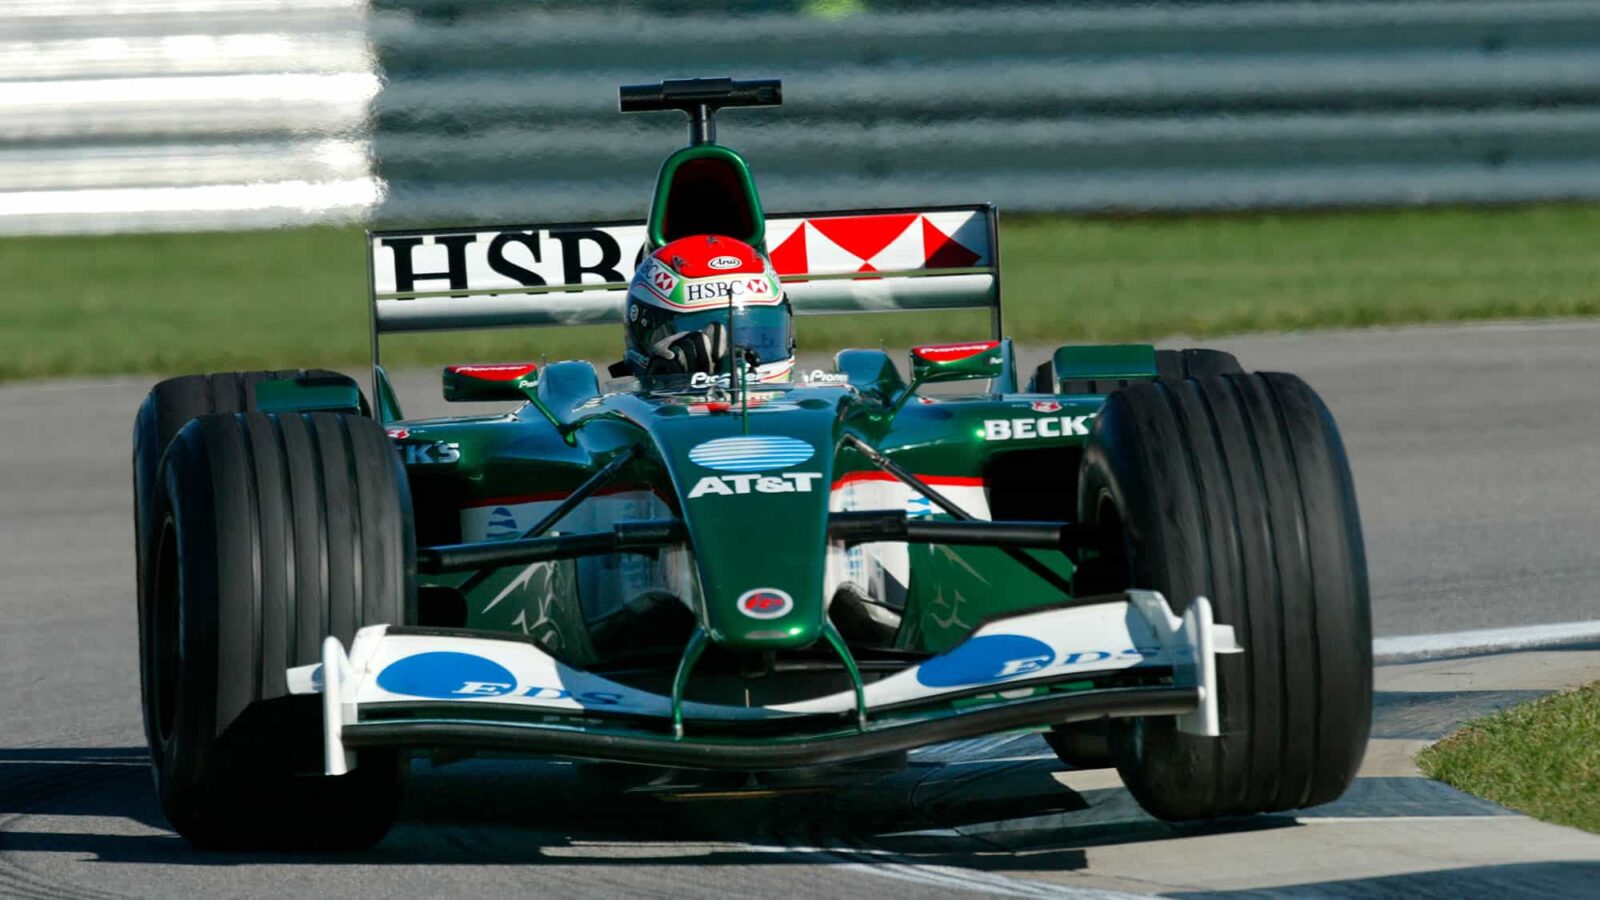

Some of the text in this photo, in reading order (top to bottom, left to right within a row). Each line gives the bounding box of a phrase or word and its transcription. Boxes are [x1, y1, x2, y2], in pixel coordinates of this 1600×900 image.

[381, 228, 646, 300] HSB
[687, 280, 744, 301] HSBC
[984, 413, 1098, 440] BECK'
[687, 472, 823, 499] AT&T
[994, 647, 1162, 678] EDS
[451, 681, 623, 705] EDS
